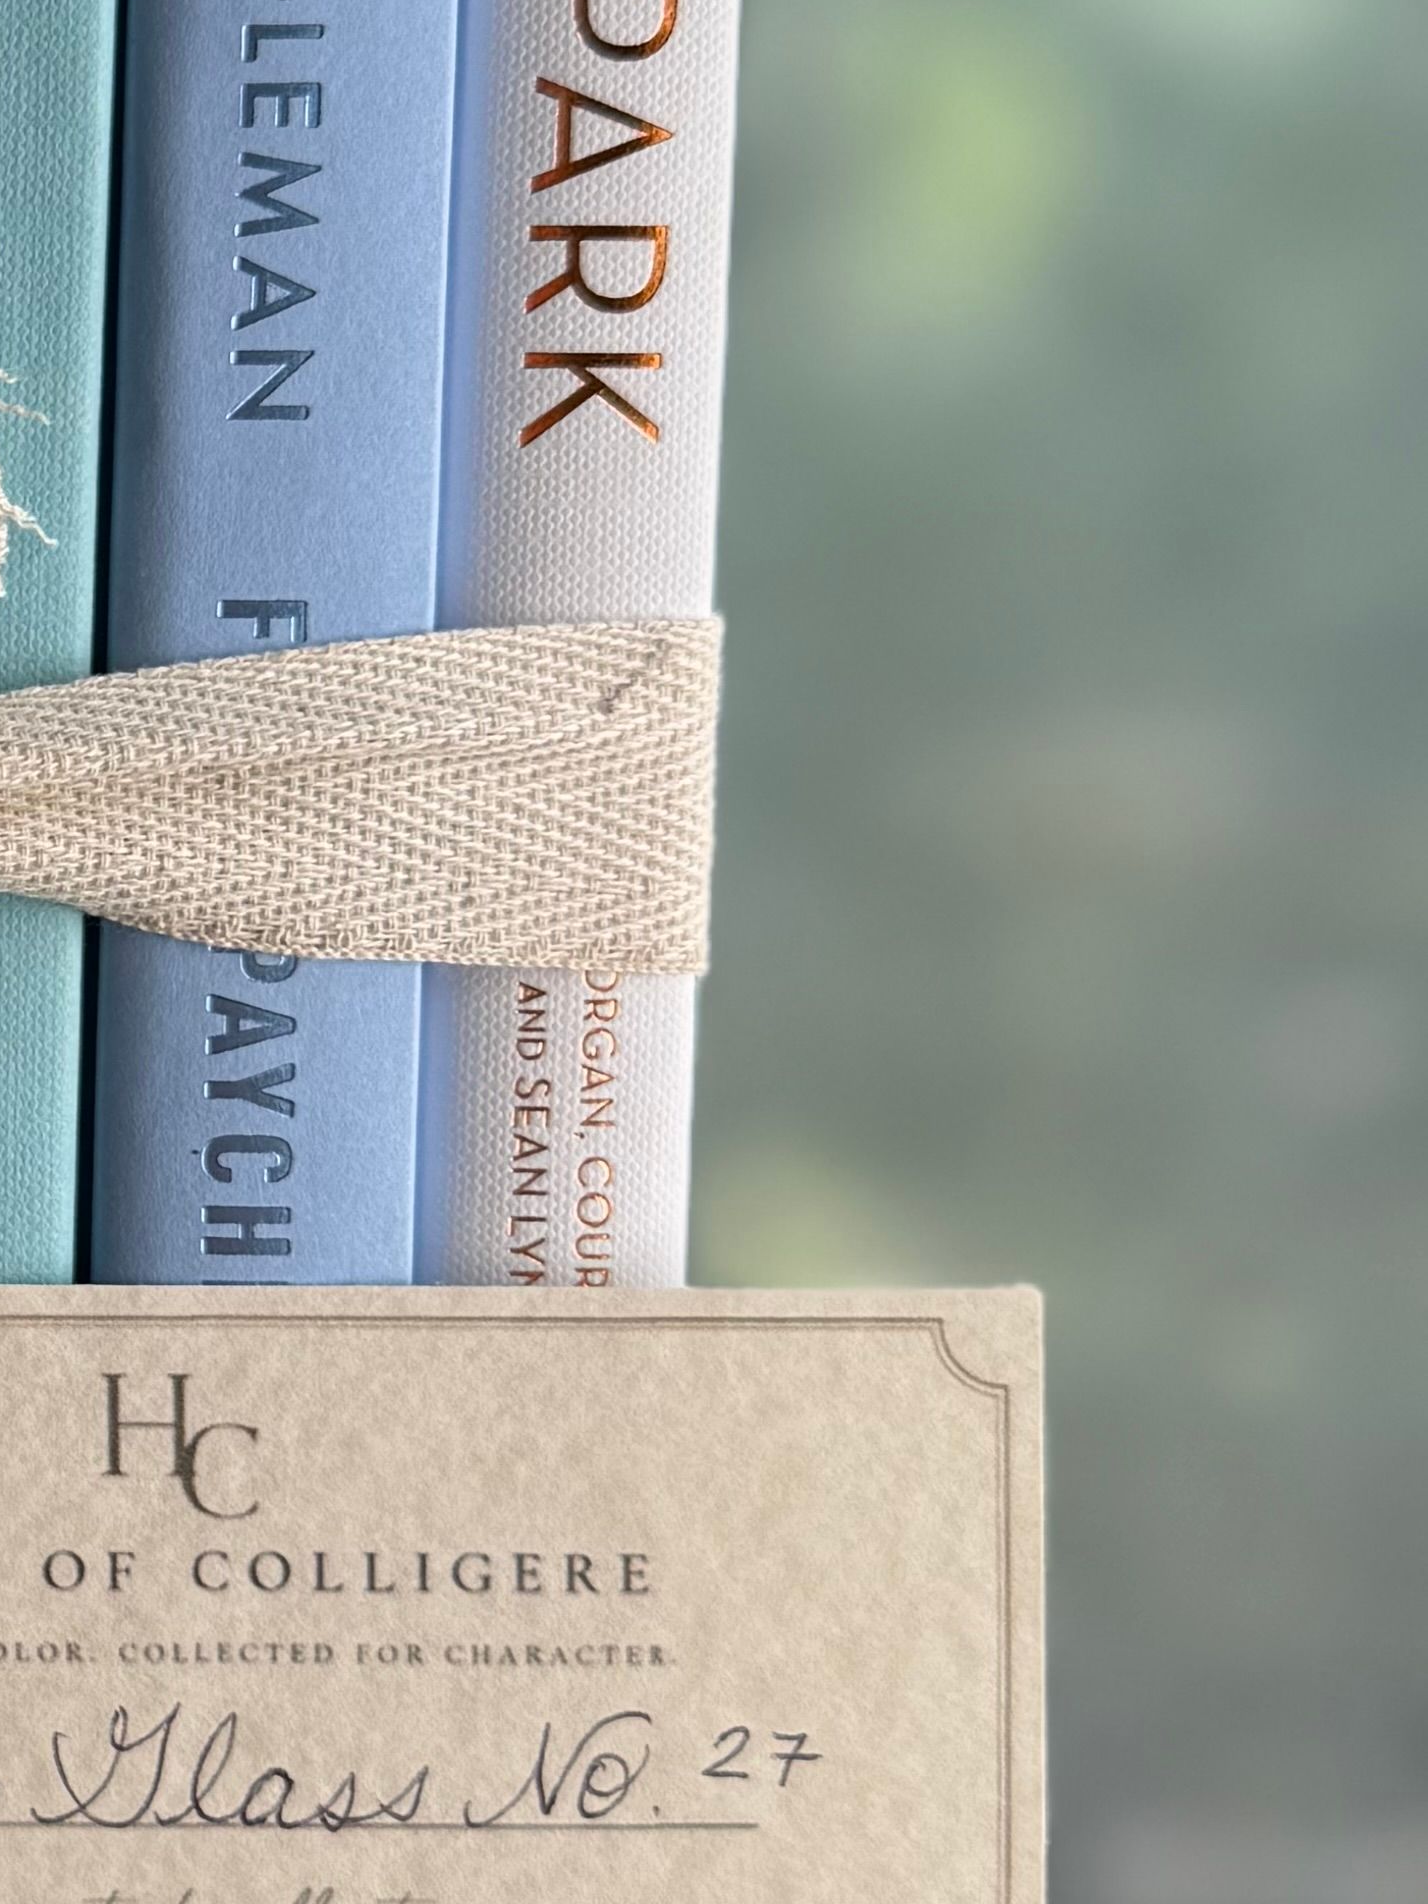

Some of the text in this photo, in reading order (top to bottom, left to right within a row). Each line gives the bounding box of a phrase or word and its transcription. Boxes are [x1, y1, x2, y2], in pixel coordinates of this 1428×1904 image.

[515, 981, 548, 1062] AND
[510, 1077, 553, 1198] SEAN
[573, 968, 621, 1287] ORGAN, COUR
[42, 1551, 135, 1592] OF
[192, 1550, 650, 1595] COLLIGERE
[118, 1641, 334, 1665] COLLECTED
[356, 1643, 424, 1666] FOR
[444, 1644, 676, 1668] CHARACTER.
[31, 1701, 430, 1832] Glass
[700, 1725, 823, 1787] 27
